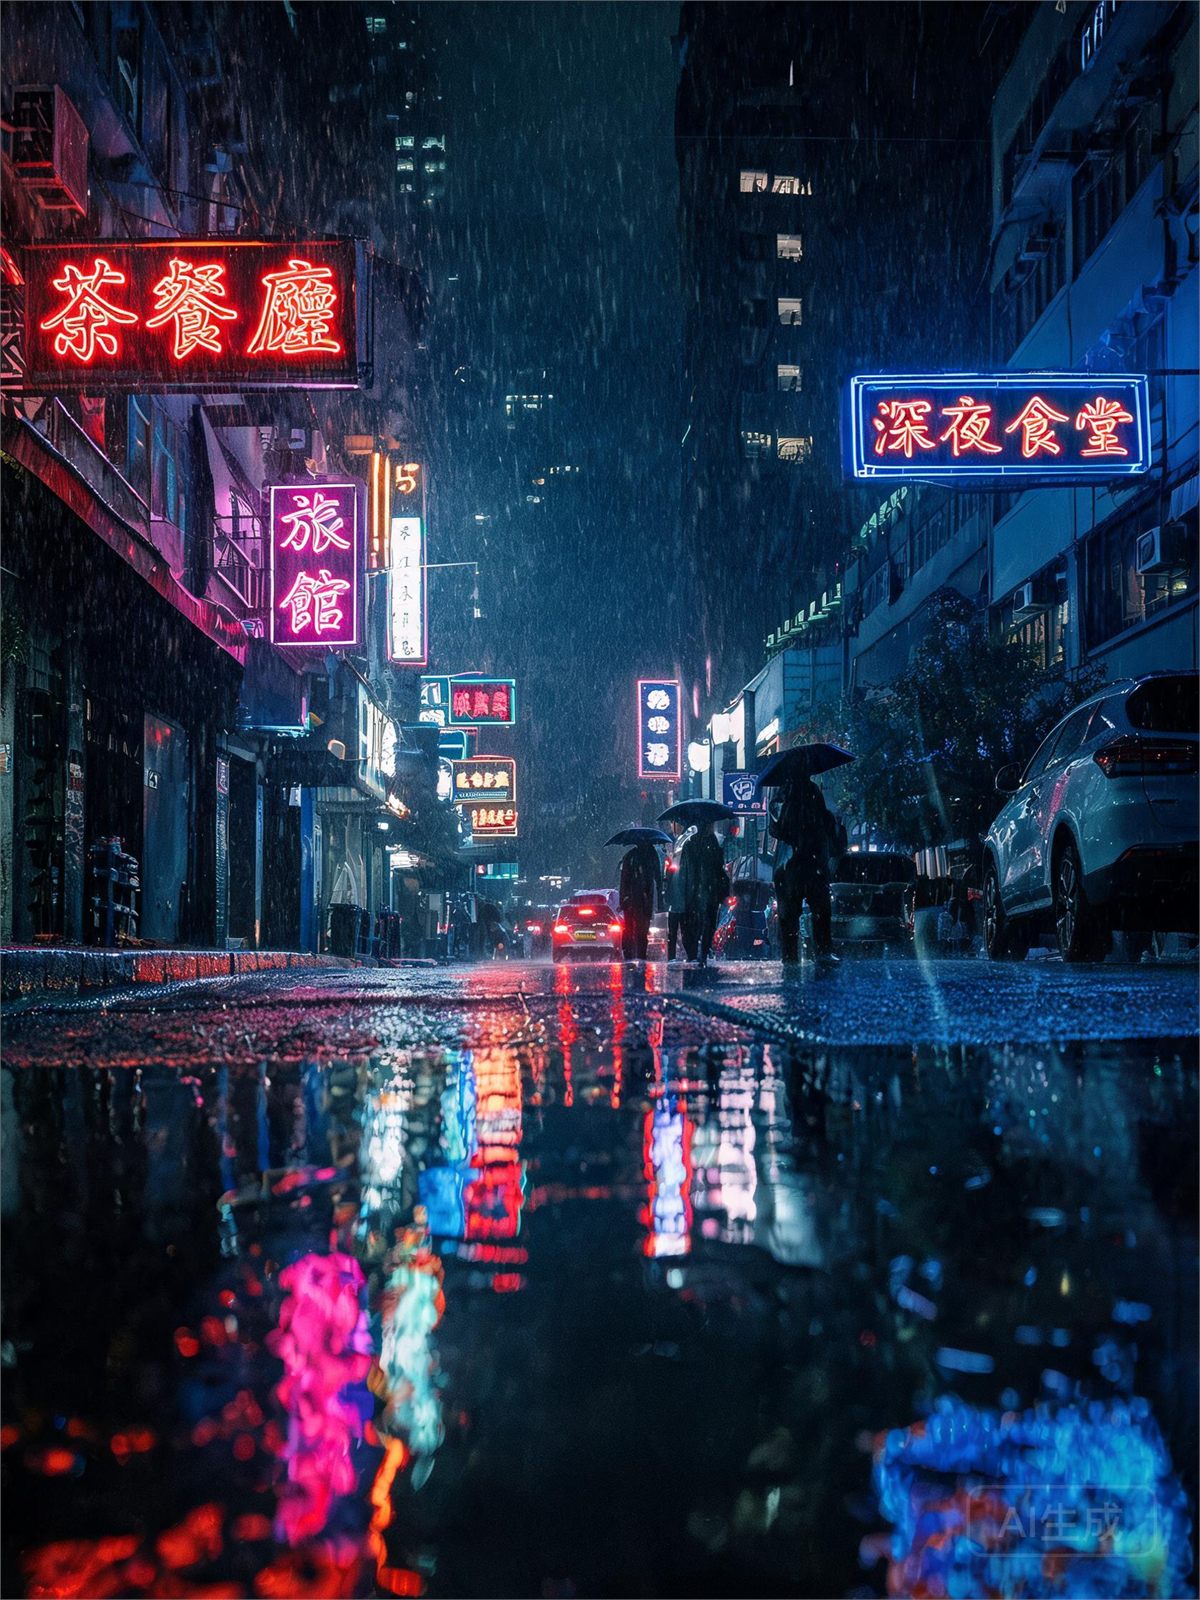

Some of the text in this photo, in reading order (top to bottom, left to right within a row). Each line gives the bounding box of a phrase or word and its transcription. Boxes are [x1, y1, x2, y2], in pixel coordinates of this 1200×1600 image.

[872, 396, 1134, 458] 深夜食堂
[279, 492, 351, 636] 旅館
